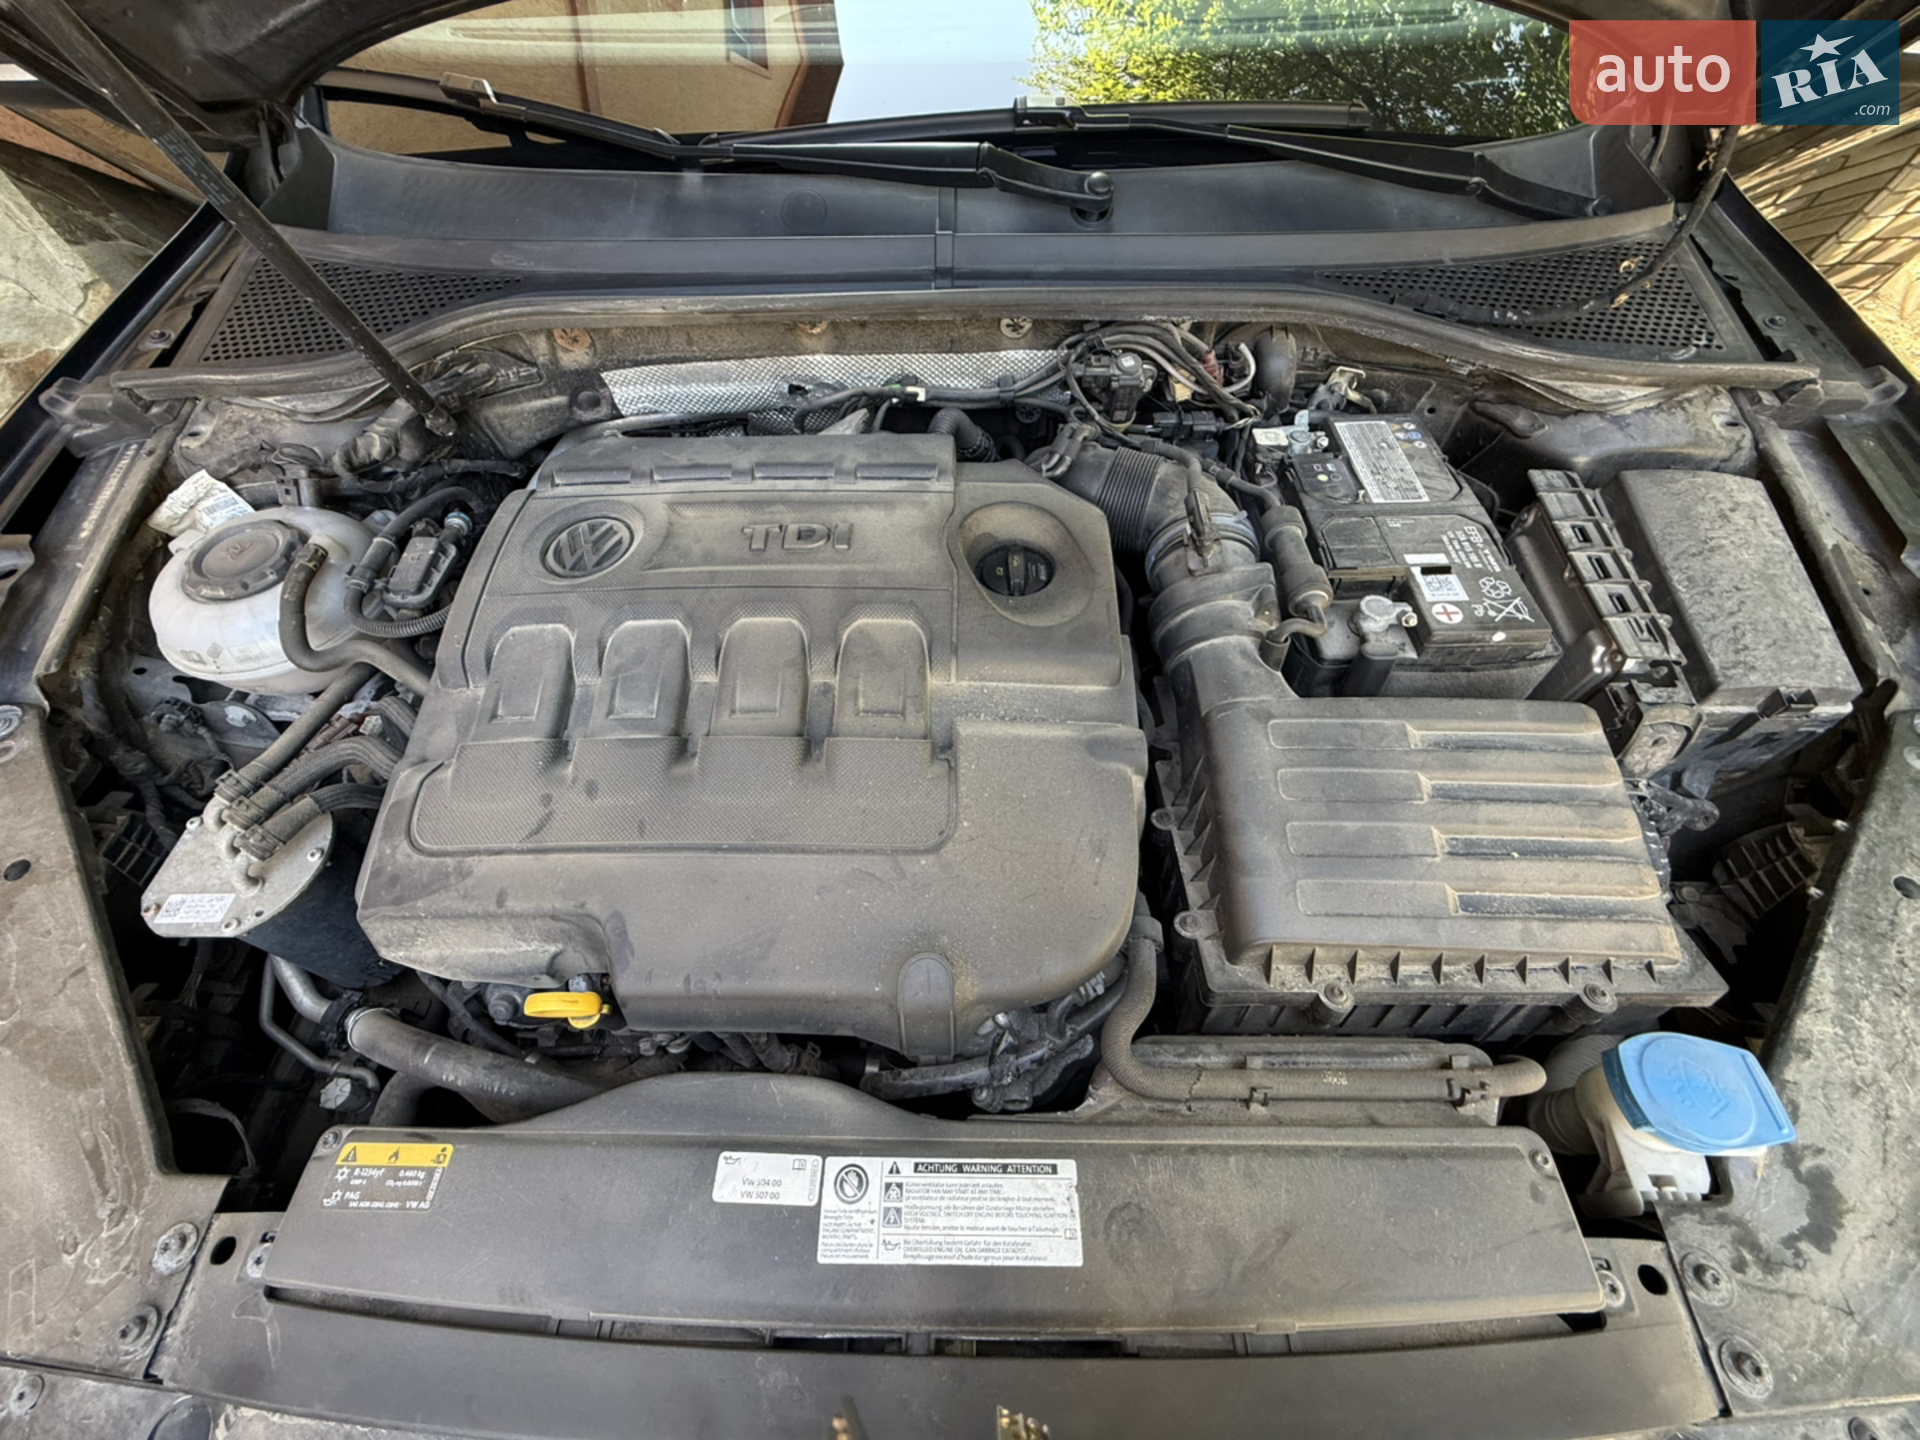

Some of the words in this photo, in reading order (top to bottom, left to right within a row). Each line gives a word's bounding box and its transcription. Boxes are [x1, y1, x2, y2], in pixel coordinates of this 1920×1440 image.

[741, 521, 854, 552] TDI
[916, 1163, 958, 1173] ACHTUNG
[962, 1164, 1003, 1174] WARNING
[1006, 1164, 1052, 1174] ATTENTION
[742, 1178, 754, 1187] VW
[757, 1178, 770, 1187] 504
[772, 1179, 782, 1188] 00
[740, 1190, 754, 1199] VW
[755, 1191, 769, 1200] 507
[769, 1191, 780, 1200] 00
